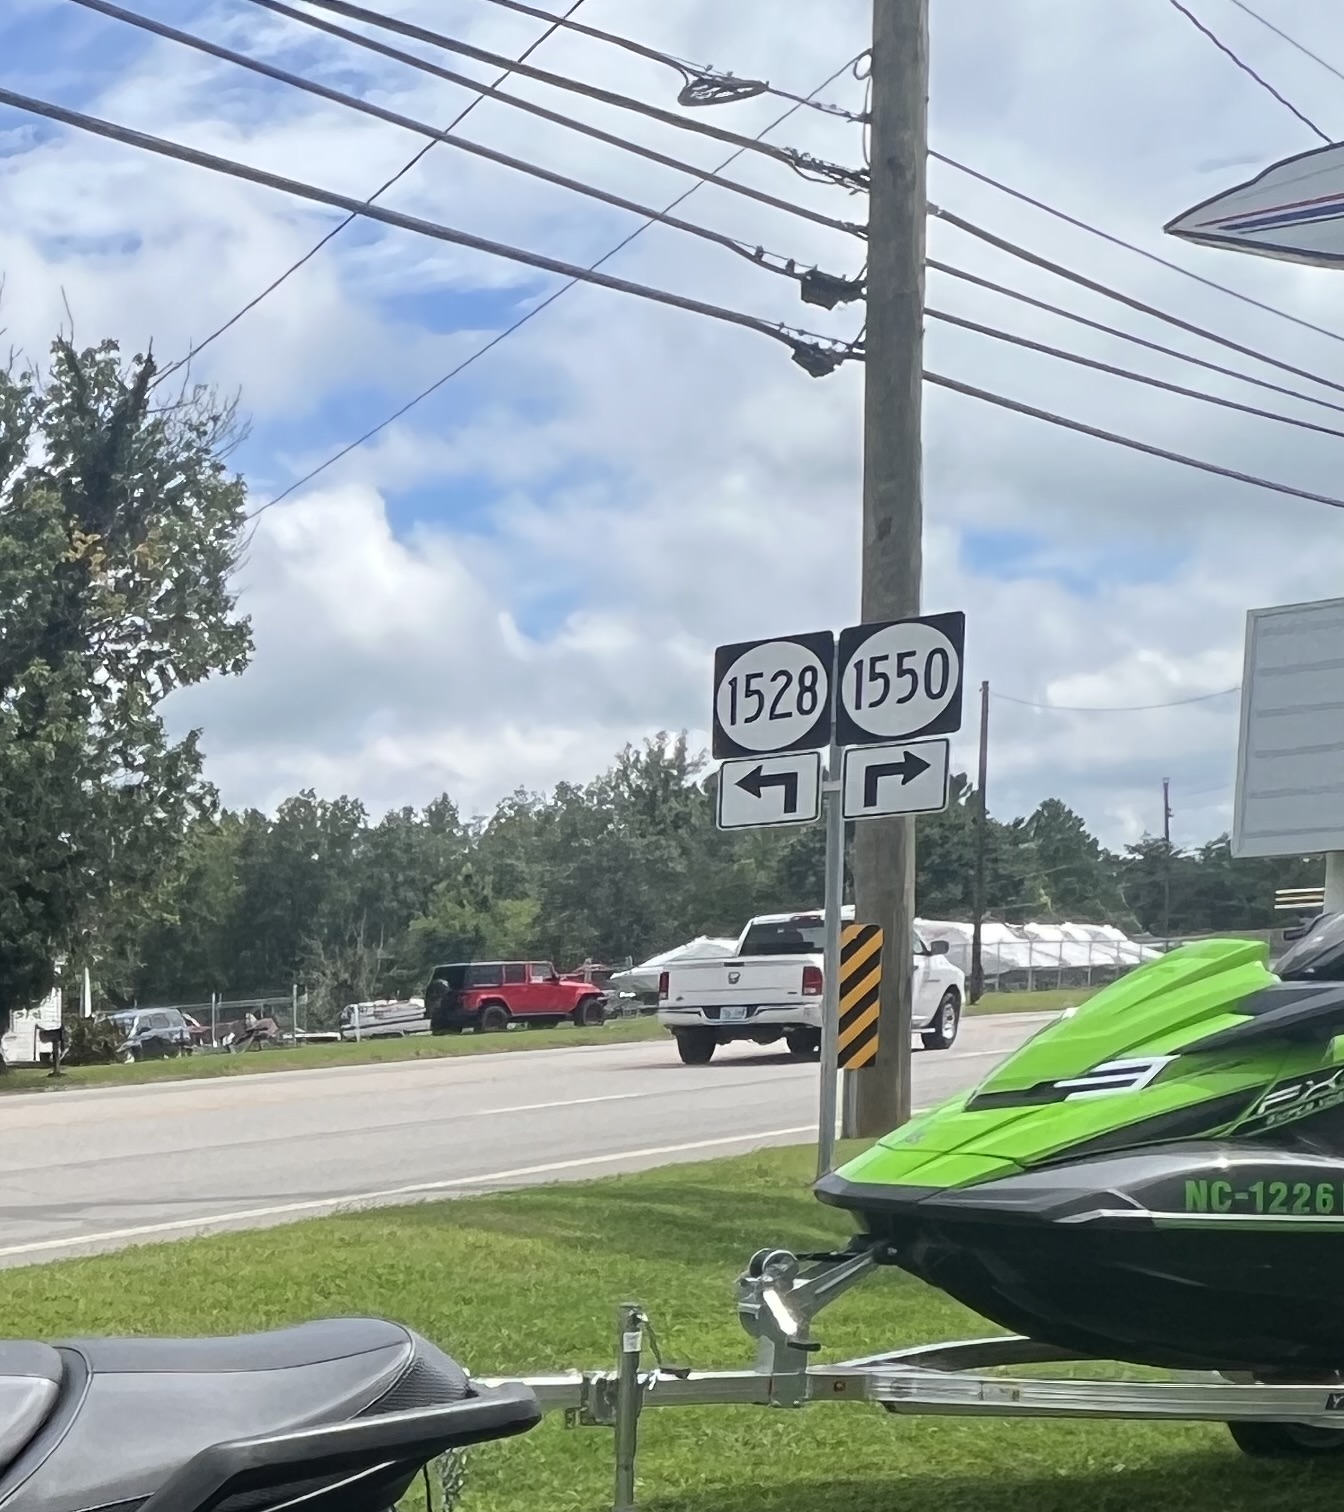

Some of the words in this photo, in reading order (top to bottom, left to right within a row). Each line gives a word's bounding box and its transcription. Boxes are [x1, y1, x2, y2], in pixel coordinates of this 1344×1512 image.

[728, 665, 818, 726] 1528
[853, 647, 949, 710] 1550
[1185, 1179, 1334, 1215] NC-1226
